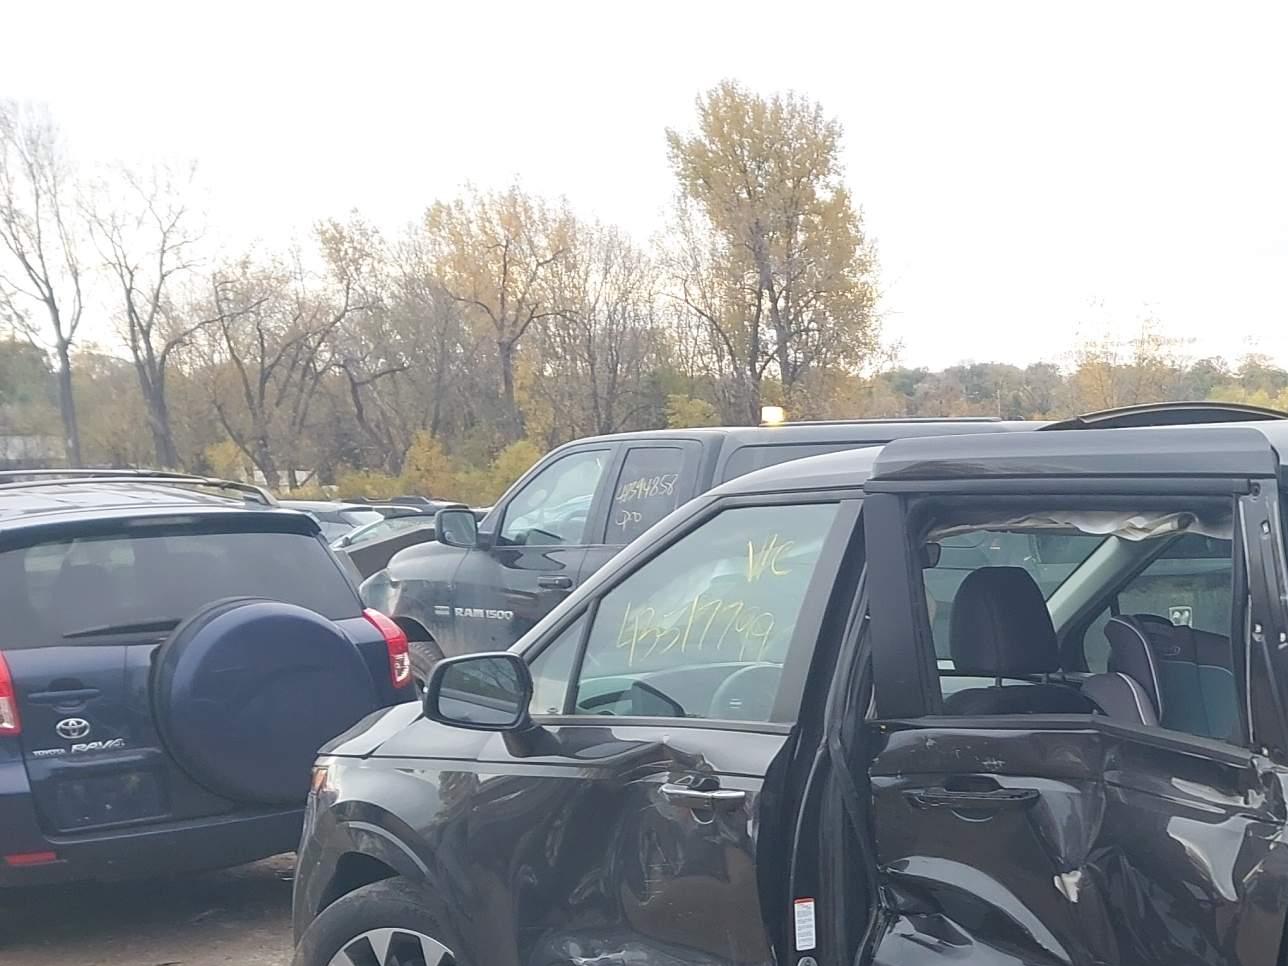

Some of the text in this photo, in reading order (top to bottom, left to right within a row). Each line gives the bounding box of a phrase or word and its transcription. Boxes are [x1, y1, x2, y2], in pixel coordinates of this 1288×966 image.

[454, 607, 514, 620] RAM 1500
[71, 738, 125, 754] RAV4
